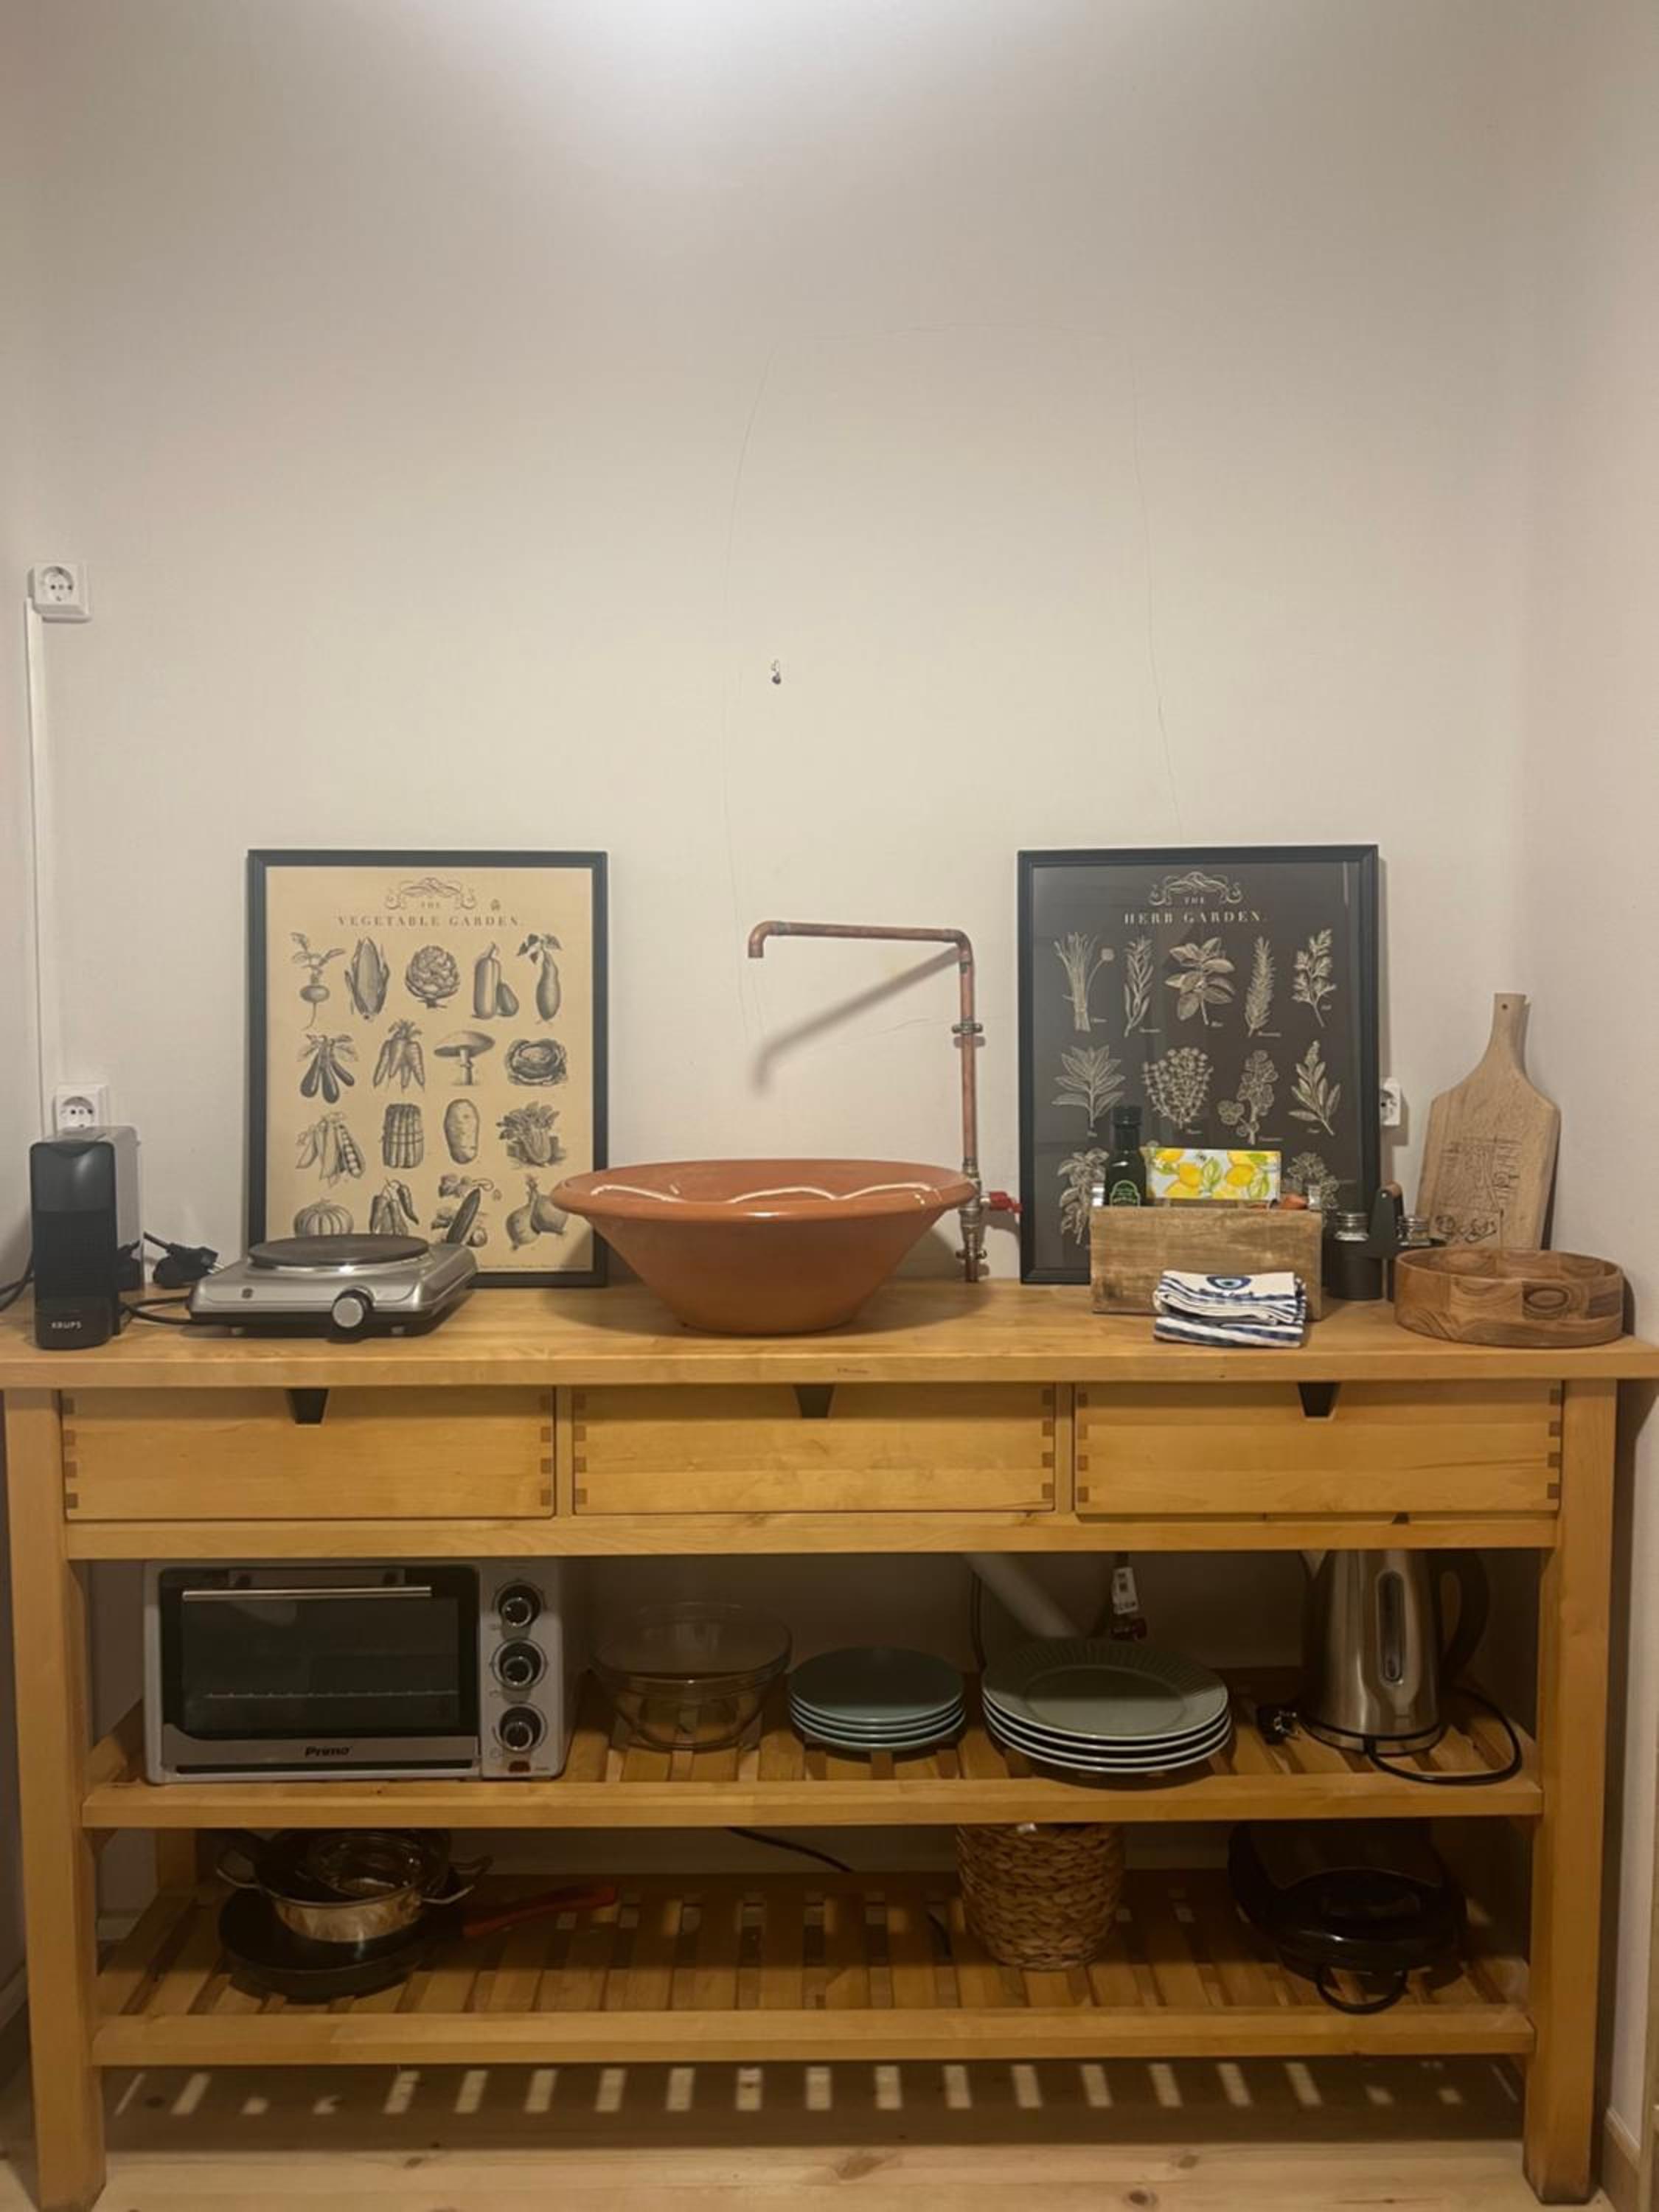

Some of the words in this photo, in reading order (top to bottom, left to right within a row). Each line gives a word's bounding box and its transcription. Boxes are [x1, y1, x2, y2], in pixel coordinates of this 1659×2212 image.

[1183, 896, 1205, 905] THE
[337, 915, 441, 928] VEGETABLE
[448, 915, 520, 928] GARDEN
[1123, 912, 1174, 925] HERB
[1183, 910, 1262, 923] GARDEN
[51, 1320, 83, 1329] KRUPS
[305, 1745, 350, 1758] Primo
